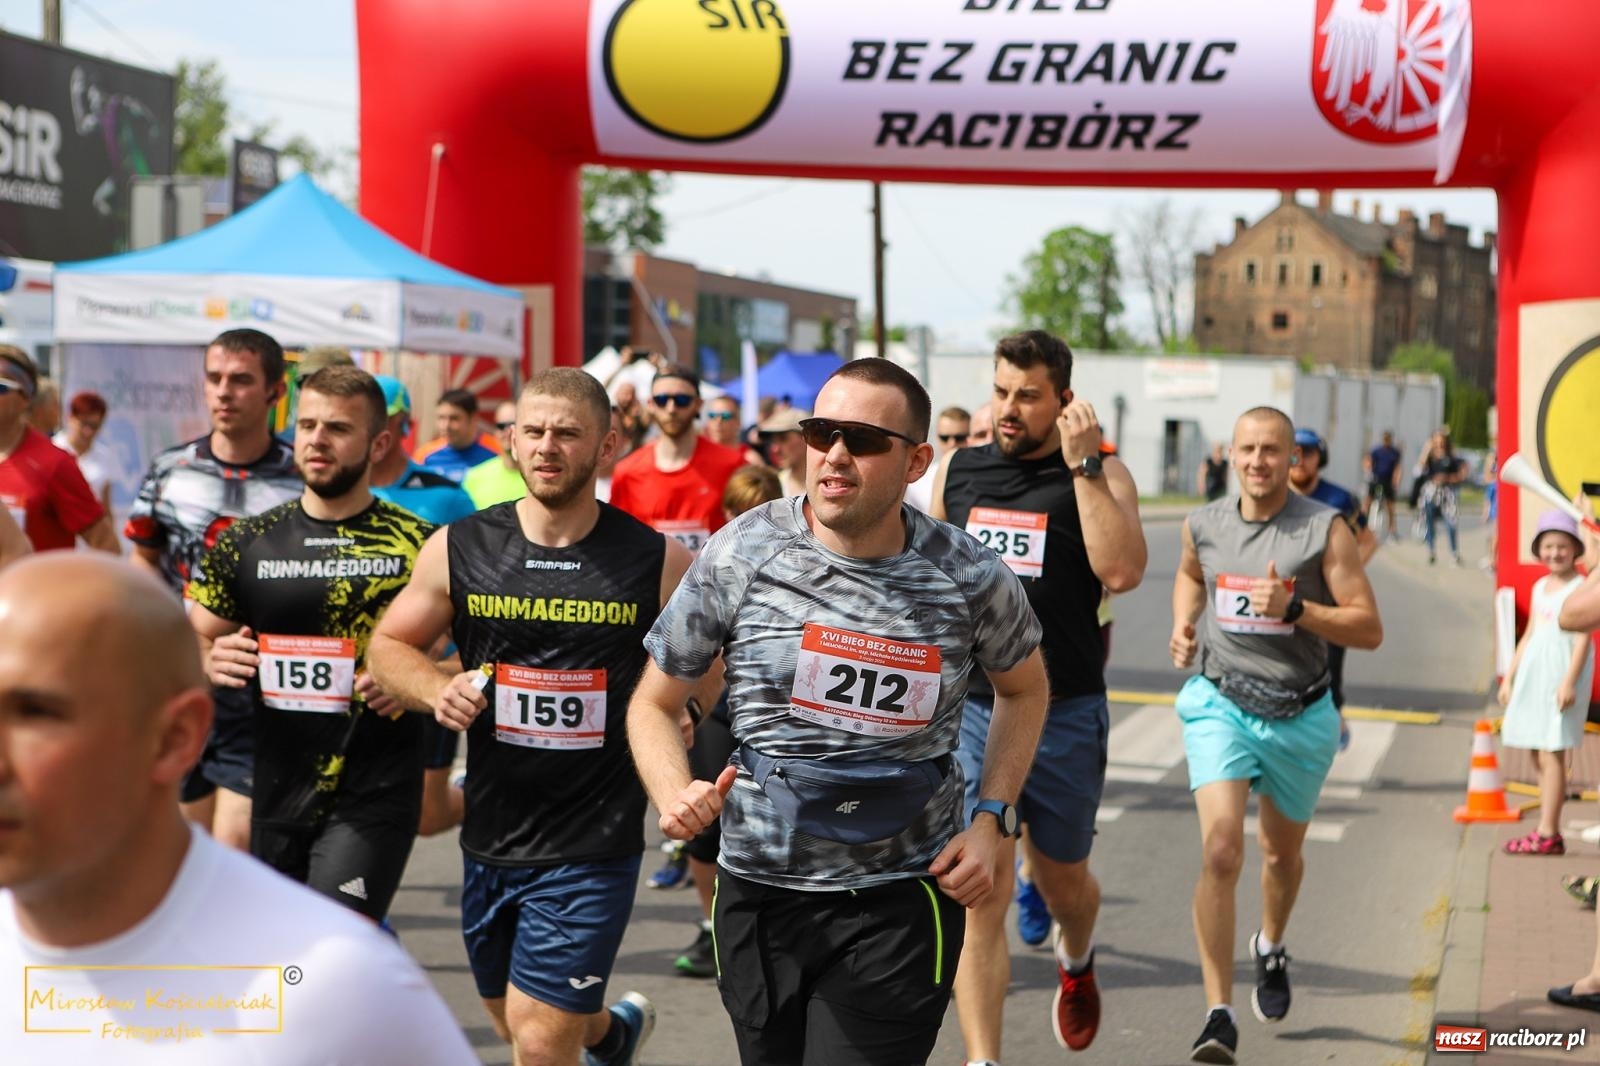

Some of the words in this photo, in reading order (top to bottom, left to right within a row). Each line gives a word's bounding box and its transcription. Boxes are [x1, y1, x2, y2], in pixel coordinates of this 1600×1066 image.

[842, 40, 974, 83] BEZ
[986, 41, 1238, 84] GRANIC
[874, 101, 1202, 151] RACIBÓRZ
[256, 557, 401, 580] RUNMAGEDDON
[525, 559, 581, 571] SMMASH
[467, 593, 638, 626] RUNMAGEDDON
[821, 630, 840, 642] XVI
[841, 634, 866, 647] BIEG
[866, 640, 887, 652] BEZ
[887, 644, 928, 658] GRANIC
[275, 660, 332, 691] 158
[824, 663, 909, 714] 212
[517, 692, 584, 728] 159
[835, 800, 860, 813] 4F
